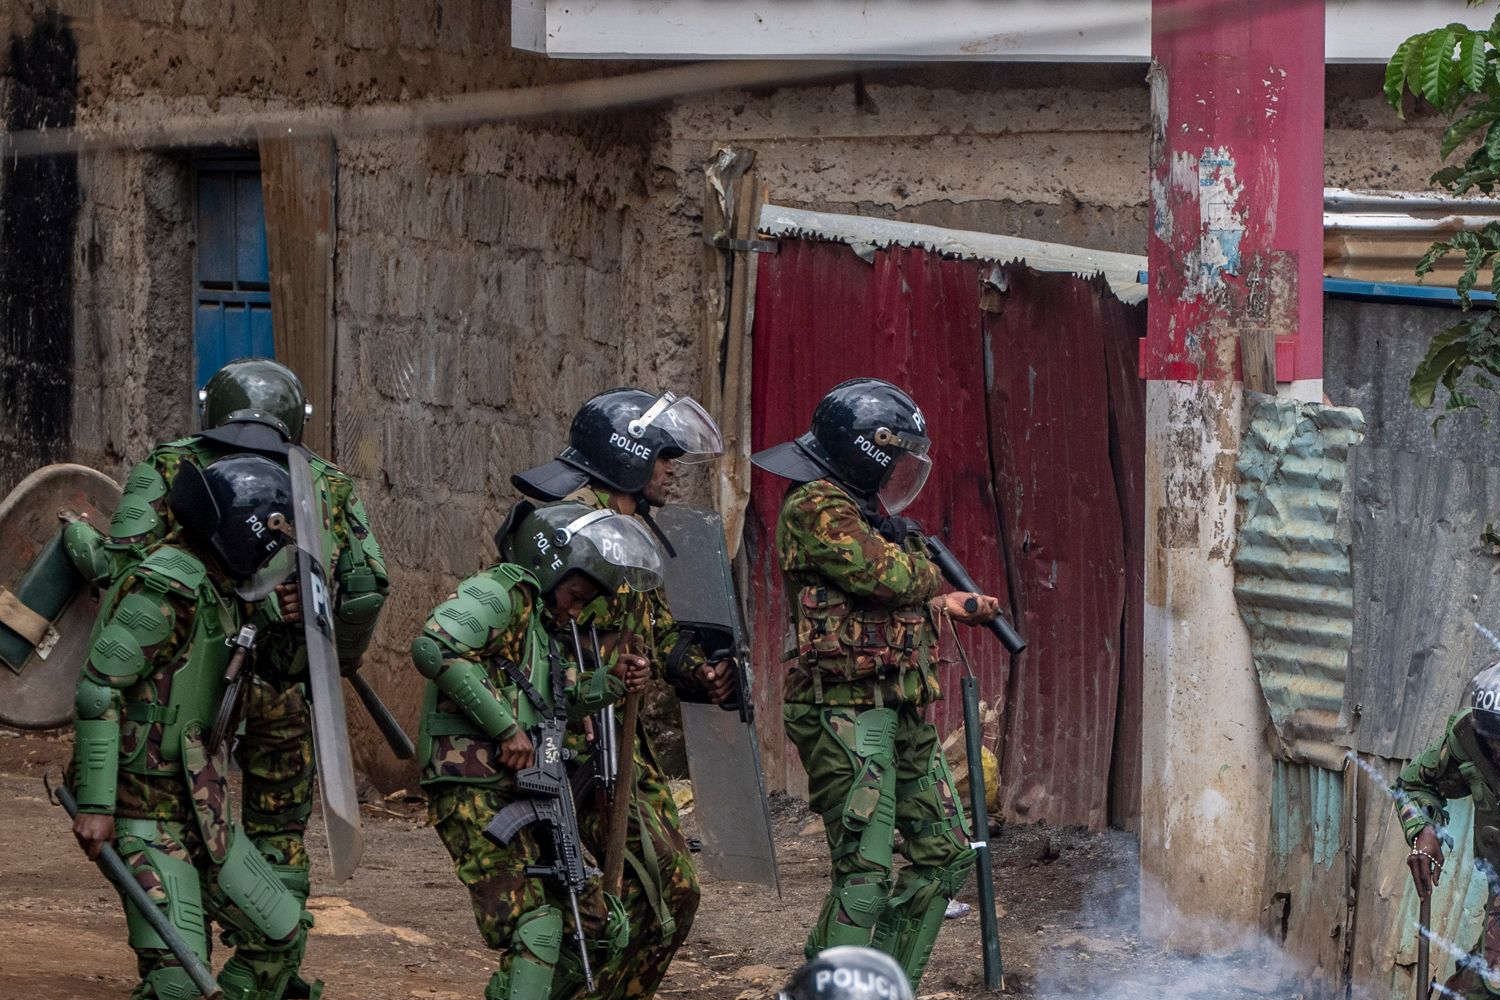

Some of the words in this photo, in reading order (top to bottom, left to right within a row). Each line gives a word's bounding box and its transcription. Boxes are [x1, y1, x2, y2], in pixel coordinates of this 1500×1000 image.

[609, 432, 652, 460] POLICE
[853, 434, 892, 468] POLICE
[245, 515, 278, 552] POLE
[533, 531, 563, 571] POLE
